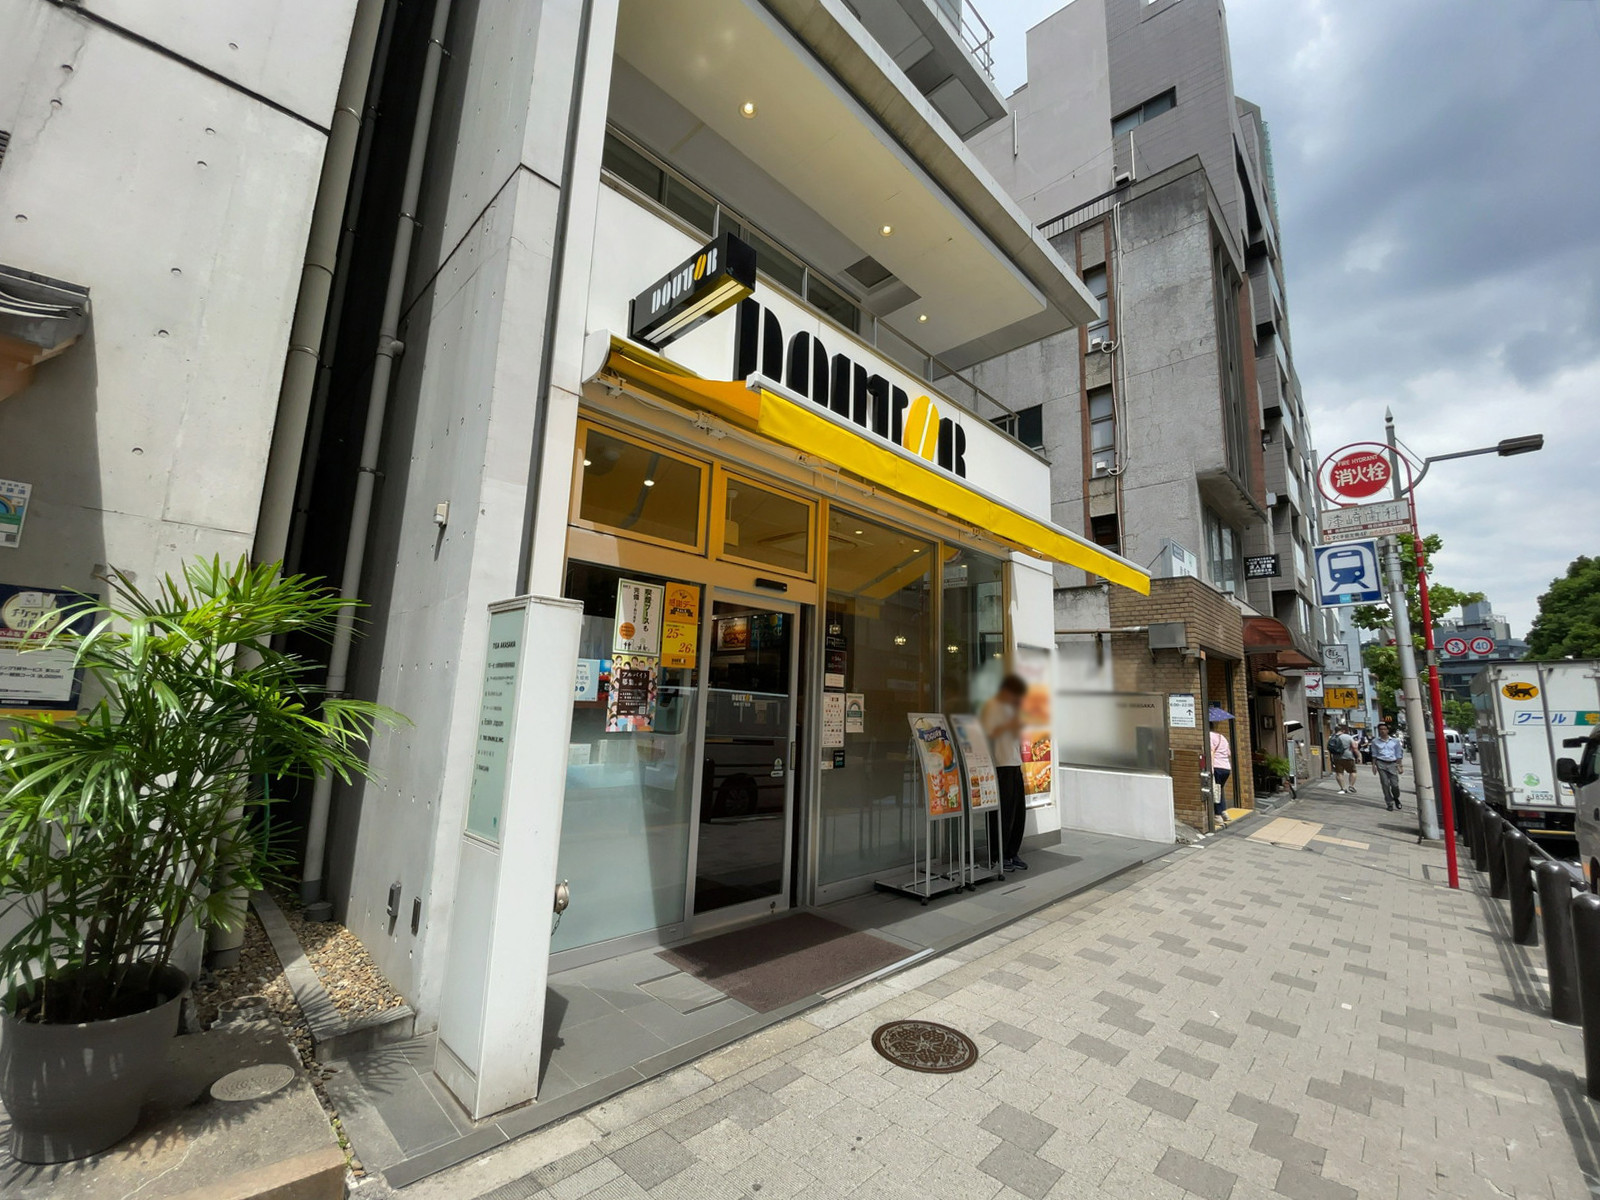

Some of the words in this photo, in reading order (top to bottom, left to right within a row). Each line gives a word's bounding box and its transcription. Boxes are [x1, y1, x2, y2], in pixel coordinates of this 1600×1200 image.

[651, 246, 718, 314] DOUTOR
[734, 296, 966, 478] DOUTOR
[1351, 455, 1378, 464] HYDRANT
[1334, 463, 1387, 488] 消火栓
[1475, 642, 1488, 651] 40
[1518, 712, 1567, 724] クール
